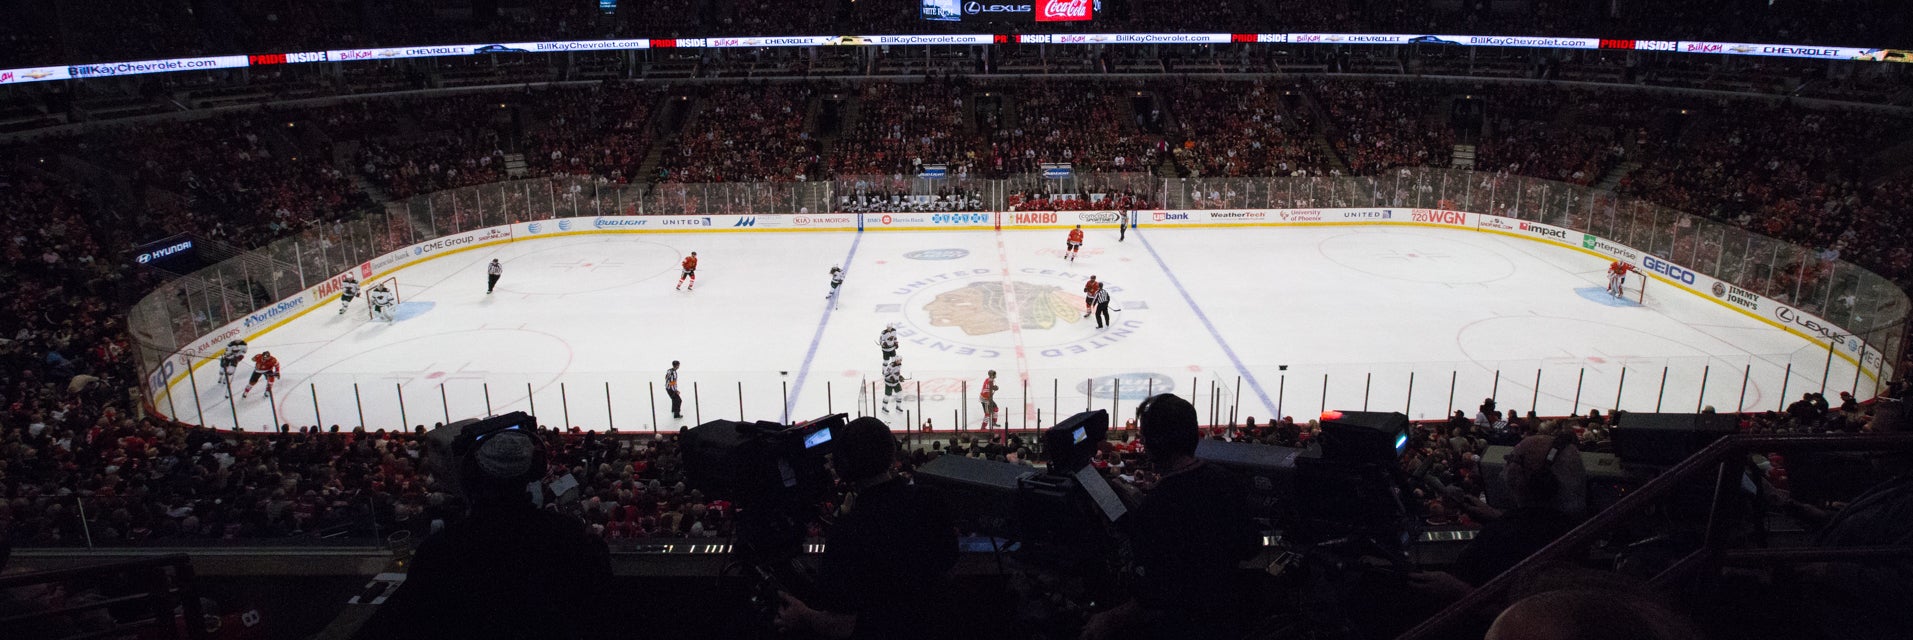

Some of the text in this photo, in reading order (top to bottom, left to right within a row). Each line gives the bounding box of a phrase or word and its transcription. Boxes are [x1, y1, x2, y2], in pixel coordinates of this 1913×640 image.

[982, 4, 1031, 12] LEXUS
[537, 40, 639, 50] BillKayChevrolet.com
[880, 36, 976, 44] BillKayChevrolet.com
[1115, 34, 1210, 42] BillKayChevrolet.com
[1470, 36, 1586, 47] BillKayChevrolet.com
[406, 46, 465, 56] CHEVROLET
[1763, 46, 1840, 56] CHEVROLET
[68, 58, 216, 76] BillKayChevrolet.com
[1016, 213, 1057, 223] HARIBO
[1411, 214, 1428, 222] 720
[1429, 210, 1465, 225] WGN
[1528, 222, 1566, 239] impact
[152, 240, 192, 259] HYUNDAI
[423, 235, 474, 253] CME Group
[1643, 255, 1695, 285] GEICO
[893, 268, 990, 295] UNITED
[1728, 286, 1760, 302] JIMMY
[250, 296, 303, 324] NorthShore
[1727, 294, 1758, 311] JOHN'S
[211, 327, 241, 345] MOTORS
[1795, 315, 1845, 345] LEXUS
